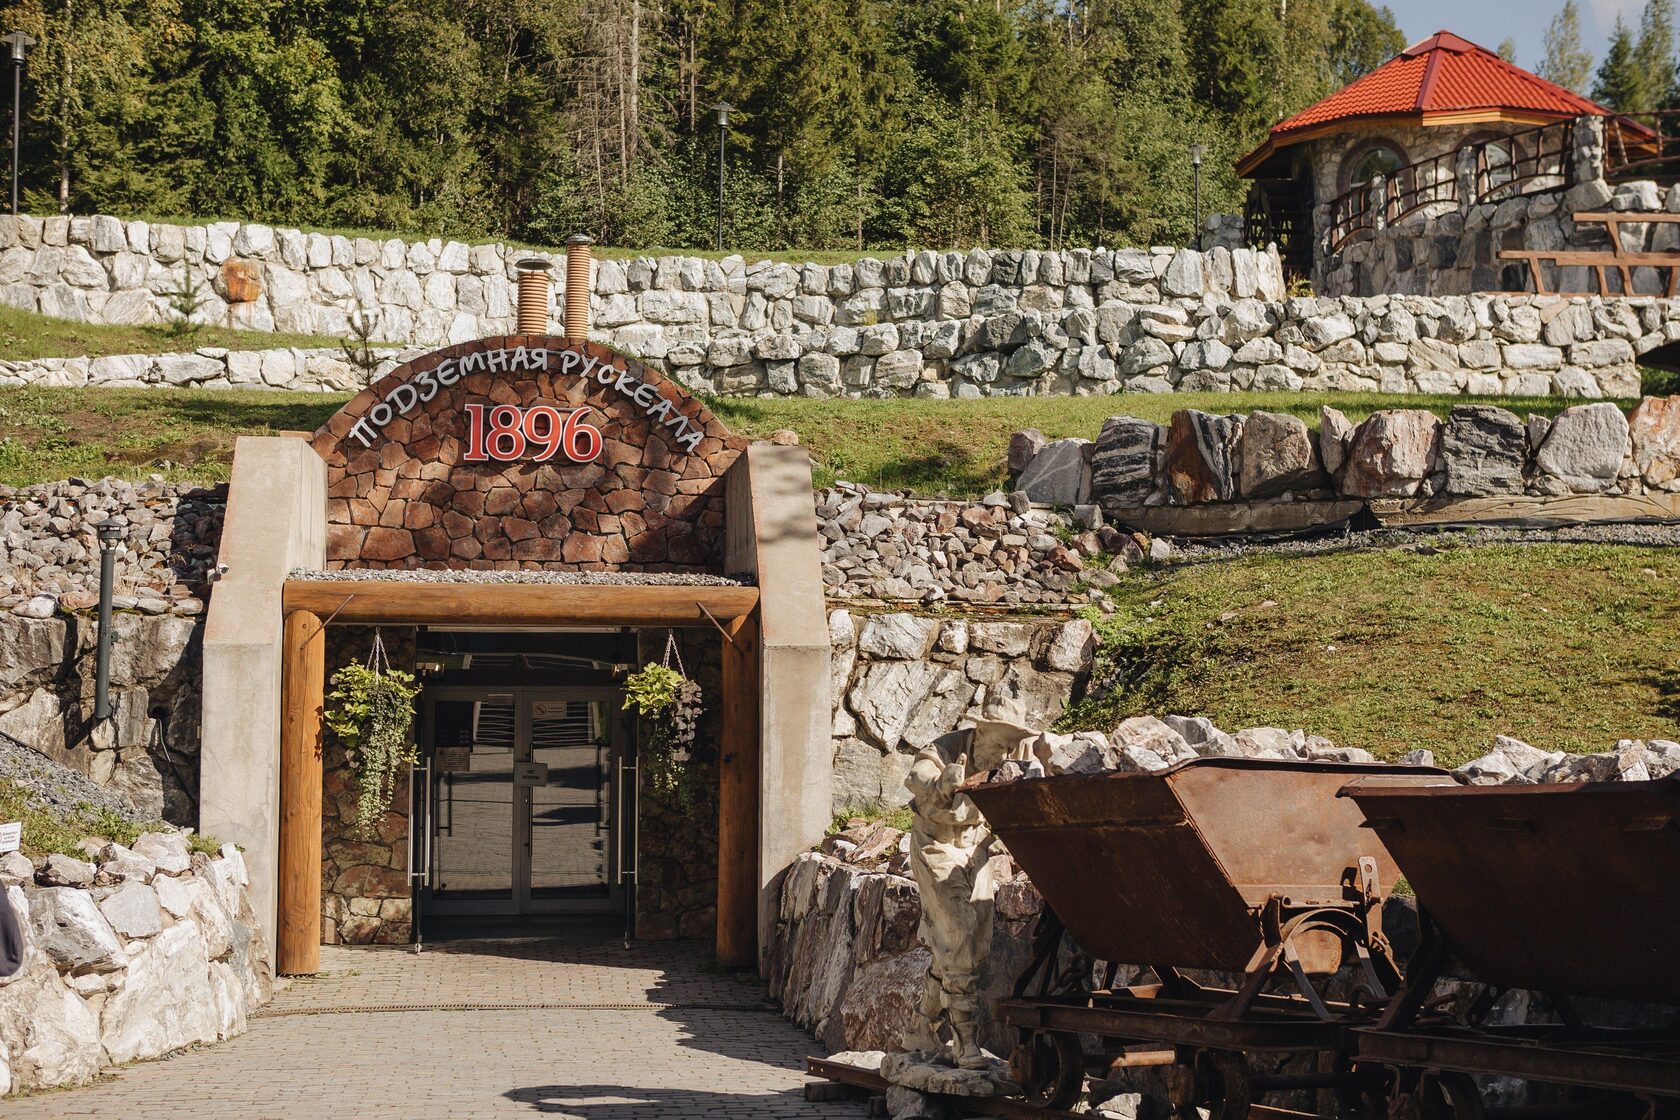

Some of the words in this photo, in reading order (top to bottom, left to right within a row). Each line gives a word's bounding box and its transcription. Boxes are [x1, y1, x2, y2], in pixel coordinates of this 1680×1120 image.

[348, 345, 548, 448] ПОДЗЕМНАЯ
[560, 350, 704, 453] РУСКЕАЛА
[463, 403, 603, 463] 1896
